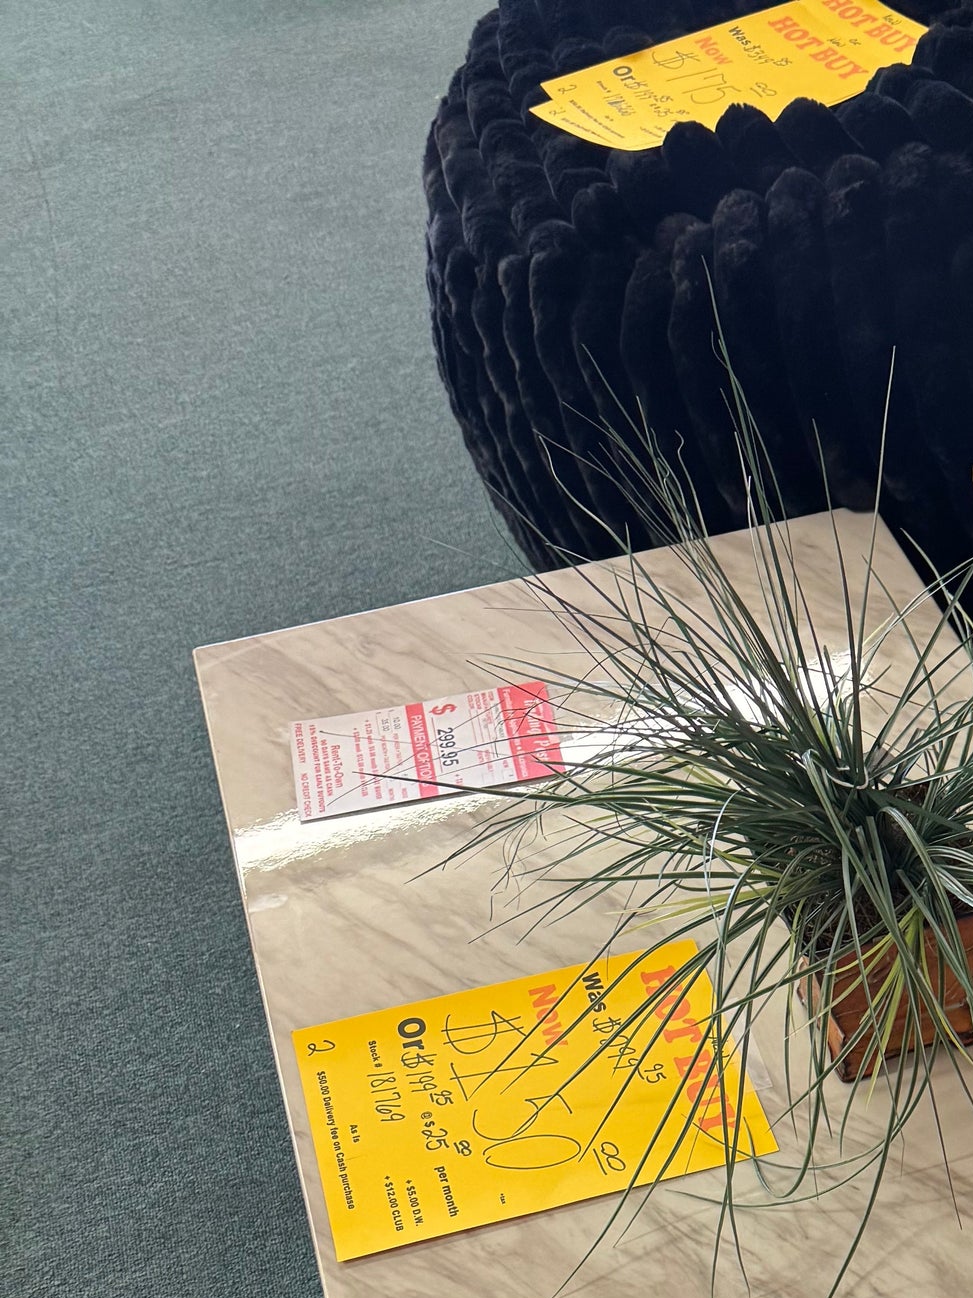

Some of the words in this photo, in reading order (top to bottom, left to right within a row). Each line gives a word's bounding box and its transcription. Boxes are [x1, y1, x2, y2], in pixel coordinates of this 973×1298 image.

[728, 25, 751, 45] Was
[822, 0, 878, 27] HOT
[863, 22, 917, 52] BUY
[694, 35, 733, 64] Now
[767, 16, 824, 49] HOT
[808, 46, 869, 79] BUY
[613, 66, 635, 81] Or
[630, 50, 742, 104] $175
[427, 702, 458, 717] $
[410, 714, 427, 751] PAYMENT
[436, 726, 460, 767] 299.95
[296, 738, 305, 762] DELIVERY
[301, 773, 307, 781] NO
[330, 744, 343, 788] Rent-To-Own
[416, 751, 434, 788] OPTIONS
[302, 782, 310, 798] CREDIT
[303, 800, 311, 816] CHECK
[579, 971, 612, 1014] Was
[527, 983, 575, 1050] Now
[638, 964, 705, 1051] HOT
[307, 1039, 335, 1056] 2
[397, 1017, 426, 1054] Or
[368, 1040, 380, 1062] Stock
[316, 1071, 329, 1095] $50.00
[671, 1047, 741, 1137] BUY
[323, 1096, 335, 1125] Delivery
[330, 1127, 338, 1139] fee
[349, 1124, 357, 1134] As
[333, 1141, 341, 1151] on
[336, 1152, 347, 1172] Cash
[338, 1173, 354, 1209] purchase
[406, 1185, 419, 1207] $5.00
[433, 1166, 448, 1182] per
[442, 1185, 459, 1217] month
[384, 1182, 398, 1208] $12.00
[392, 1209, 403, 1231] CLUB
[412, 1208, 423, 1226] D.W.
